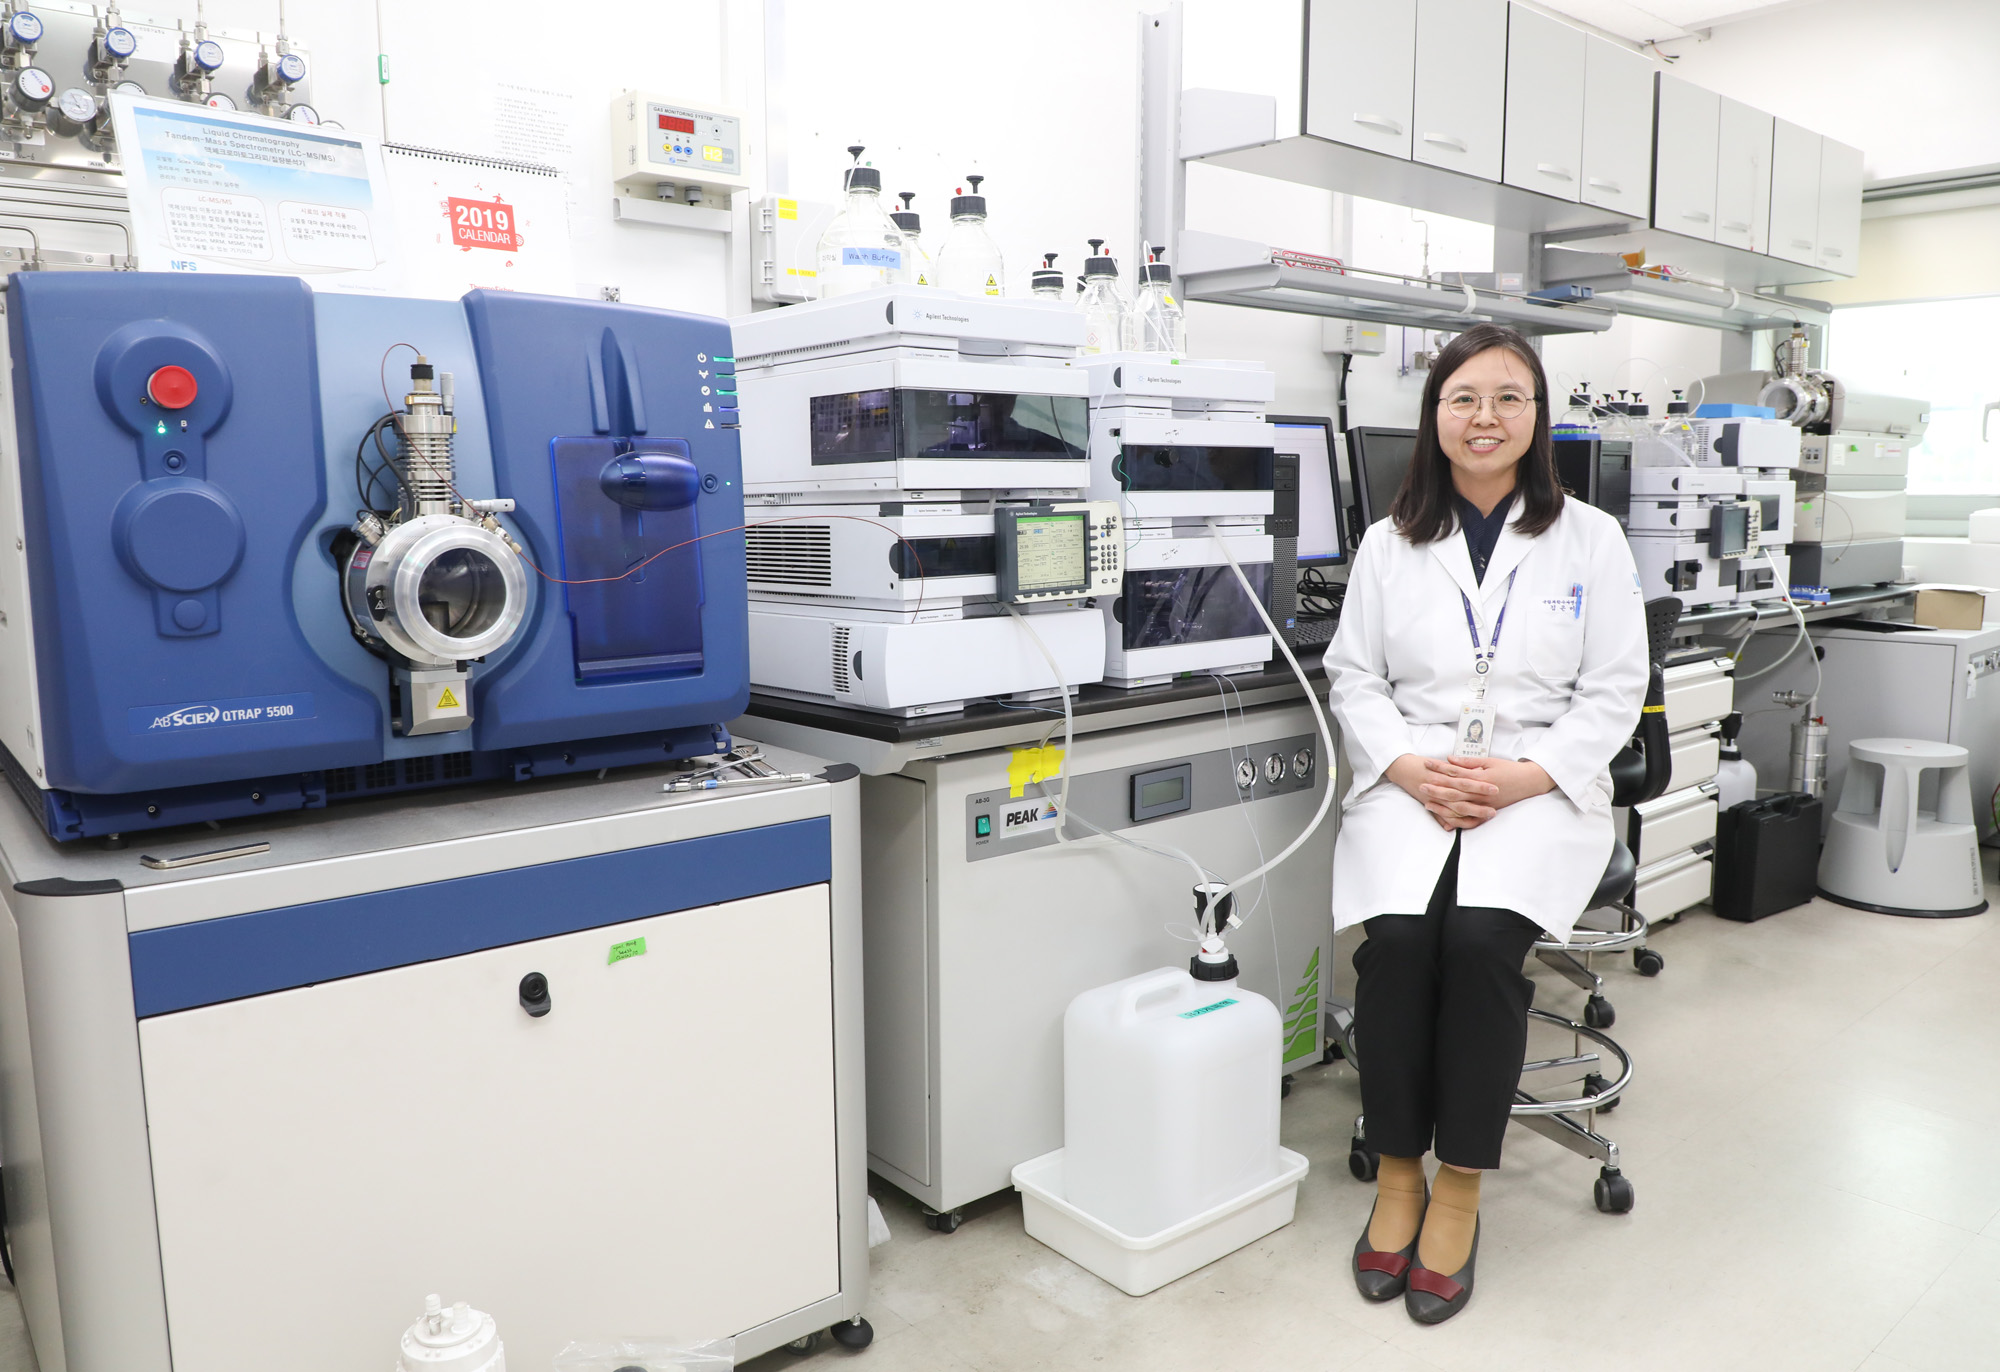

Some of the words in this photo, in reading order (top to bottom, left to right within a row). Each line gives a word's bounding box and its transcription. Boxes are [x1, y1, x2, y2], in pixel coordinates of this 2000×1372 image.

[664, 108, 694, 118] MONITORING
[164, 130, 227, 146] Tandem-Mass
[230, 140, 285, 155] Spectrometry
[288, 149, 336, 162] (LC-MS/MS)
[203, 128, 230, 138] Liquid
[232, 132, 300, 148] Chromatography
[703, 147, 722, 161] H2
[455, 205, 508, 230] 2019
[458, 227, 511, 245] CALENDAR
[170, 258, 198, 272] NFS
[872, 253, 896, 263] Buffer
[926, 312, 942, 320] Agilent
[942, 314, 970, 323] Technologies
[152, 716, 171, 728] AB
[173, 712, 215, 727] SCIEX
[222, 707, 262, 722] QTRAP
[266, 705, 294, 718] 5500
[1006, 808, 1039, 827] PEAK
